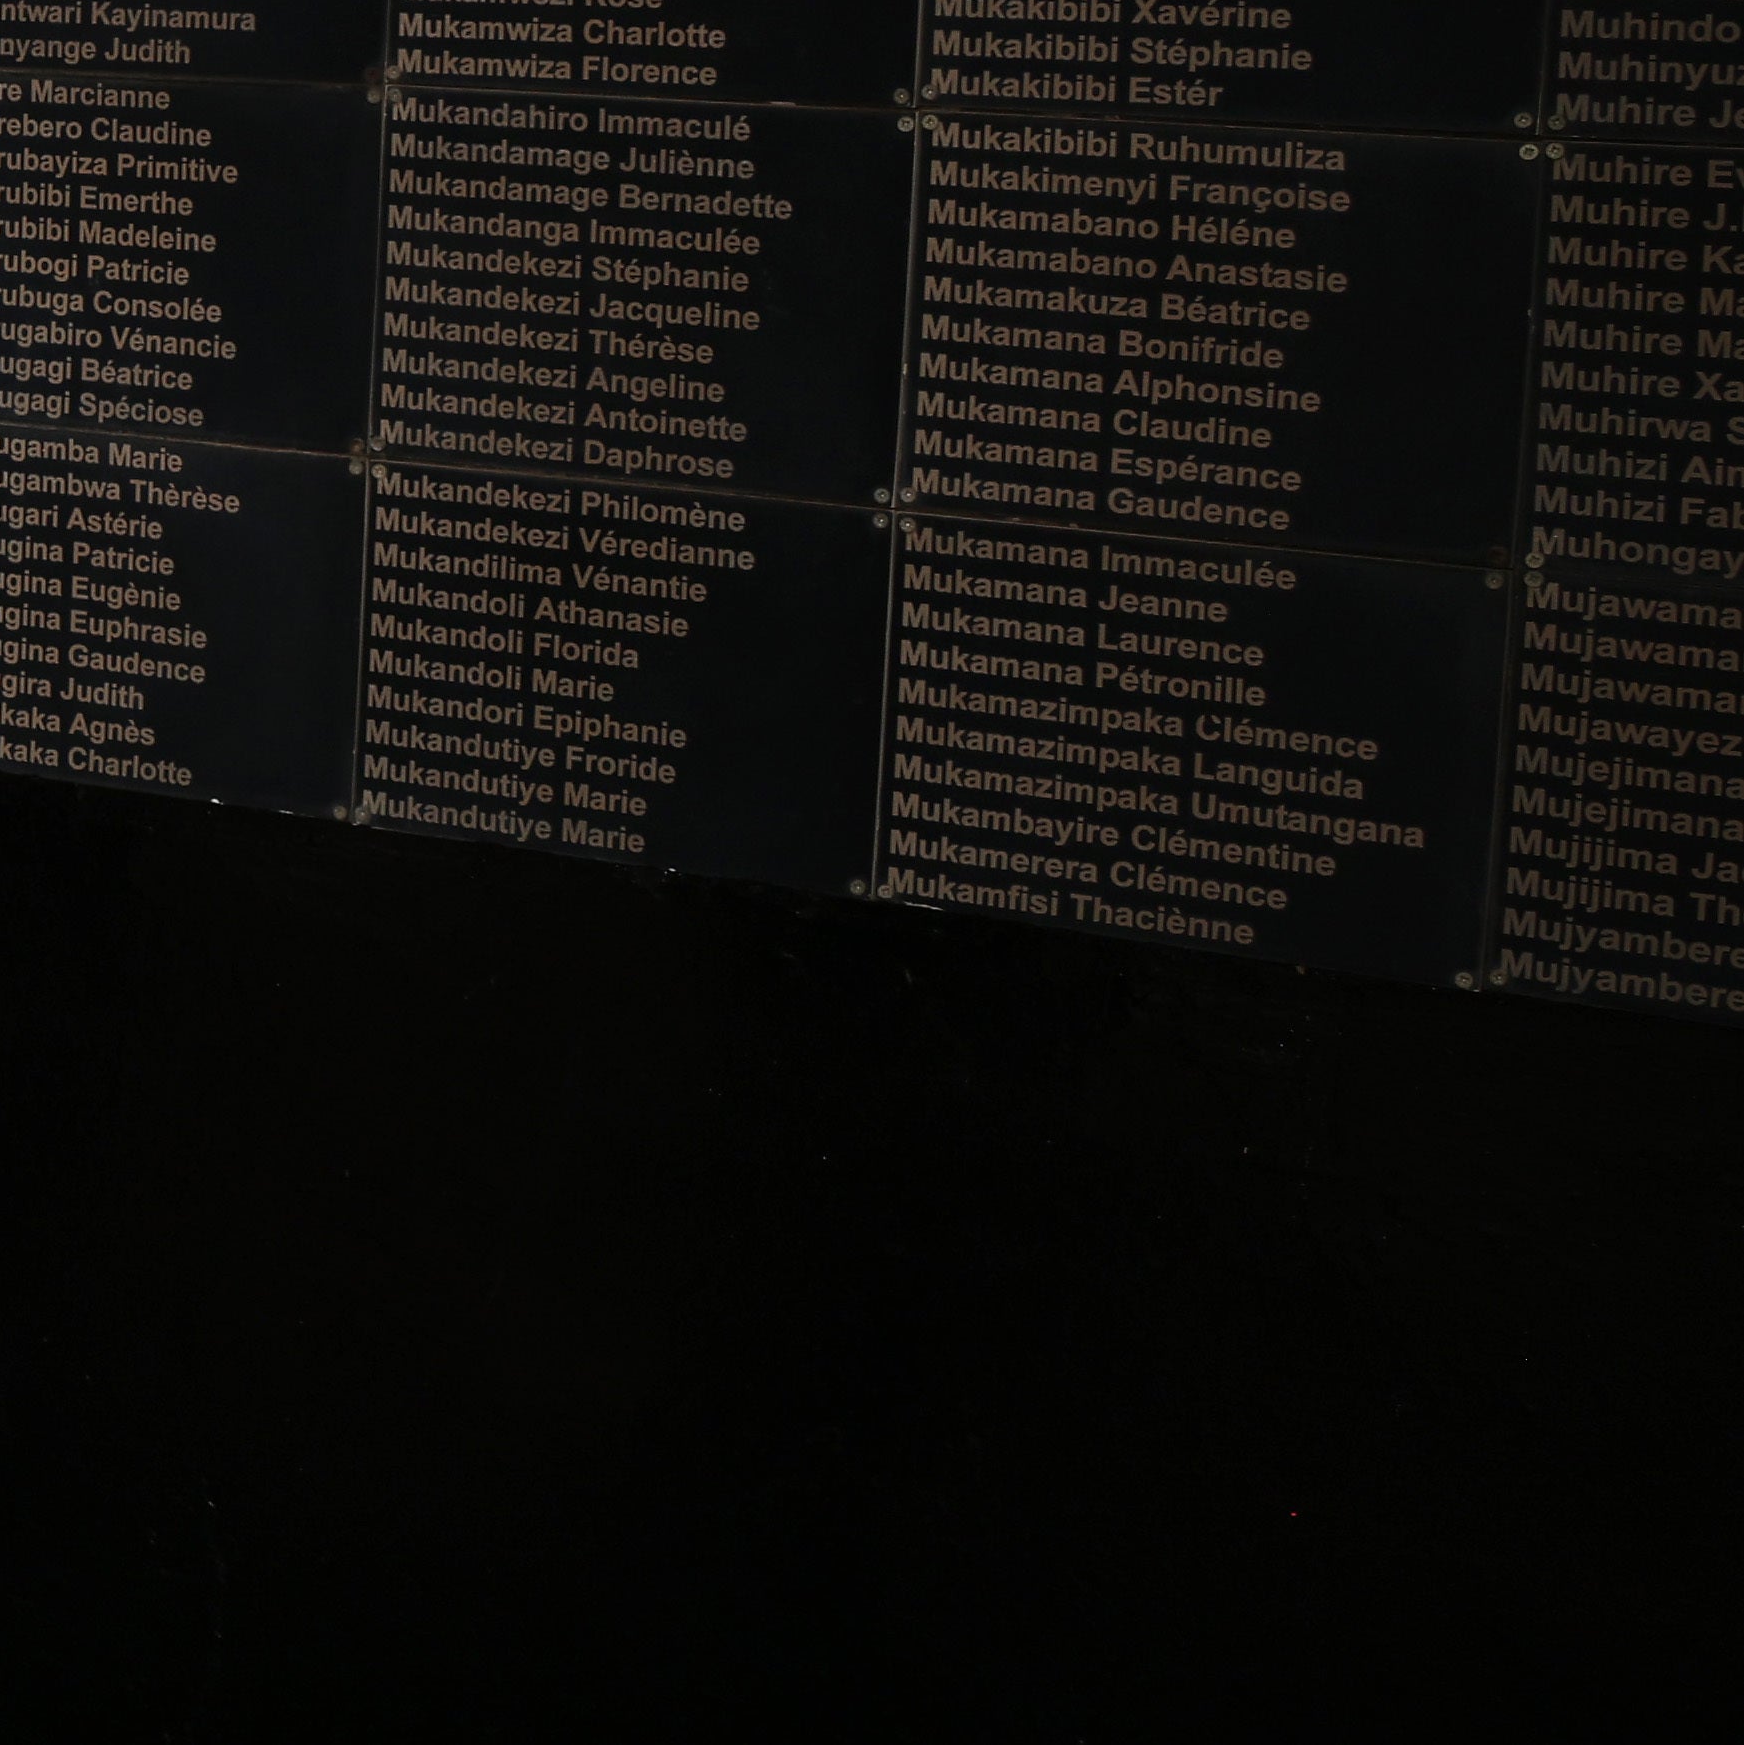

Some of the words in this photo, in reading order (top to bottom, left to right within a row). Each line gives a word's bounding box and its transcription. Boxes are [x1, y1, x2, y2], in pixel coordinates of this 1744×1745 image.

[91, 1, 256, 33] Kayinamura
[117, 153, 239, 184] Primitive
[390, 132, 611, 175] Mukandamage
[619, 146, 755, 179] Juliènne
[388, 204, 579, 247] Mukandanga
[590, 218, 761, 255] Immaculée
[928, 198, 1159, 240] Mukamabano
[385, 275, 580, 316] Mukandekezi
[589, 292, 760, 331] Jacqueline
[923, 275, 1148, 318] Mukamakuza
[1160, 293, 1311, 331] Béatrice
[110, 325, 237, 360] Vénancie
[1539, 403, 1710, 442] Muhirwa
[1537, 444, 1667, 481] Muhizi
[373, 541, 562, 586] Mukandilima
[572, 563, 708, 603] Vénantie
[894, 753, 1178, 816] Mukamazimpaka
[1191, 791, 1424, 849] Umutangana
[891, 790, 1119, 847] Mukambayire
[1131, 824, 1336, 877] Clémentine
[1507, 867, 1673, 916] Mujijima
